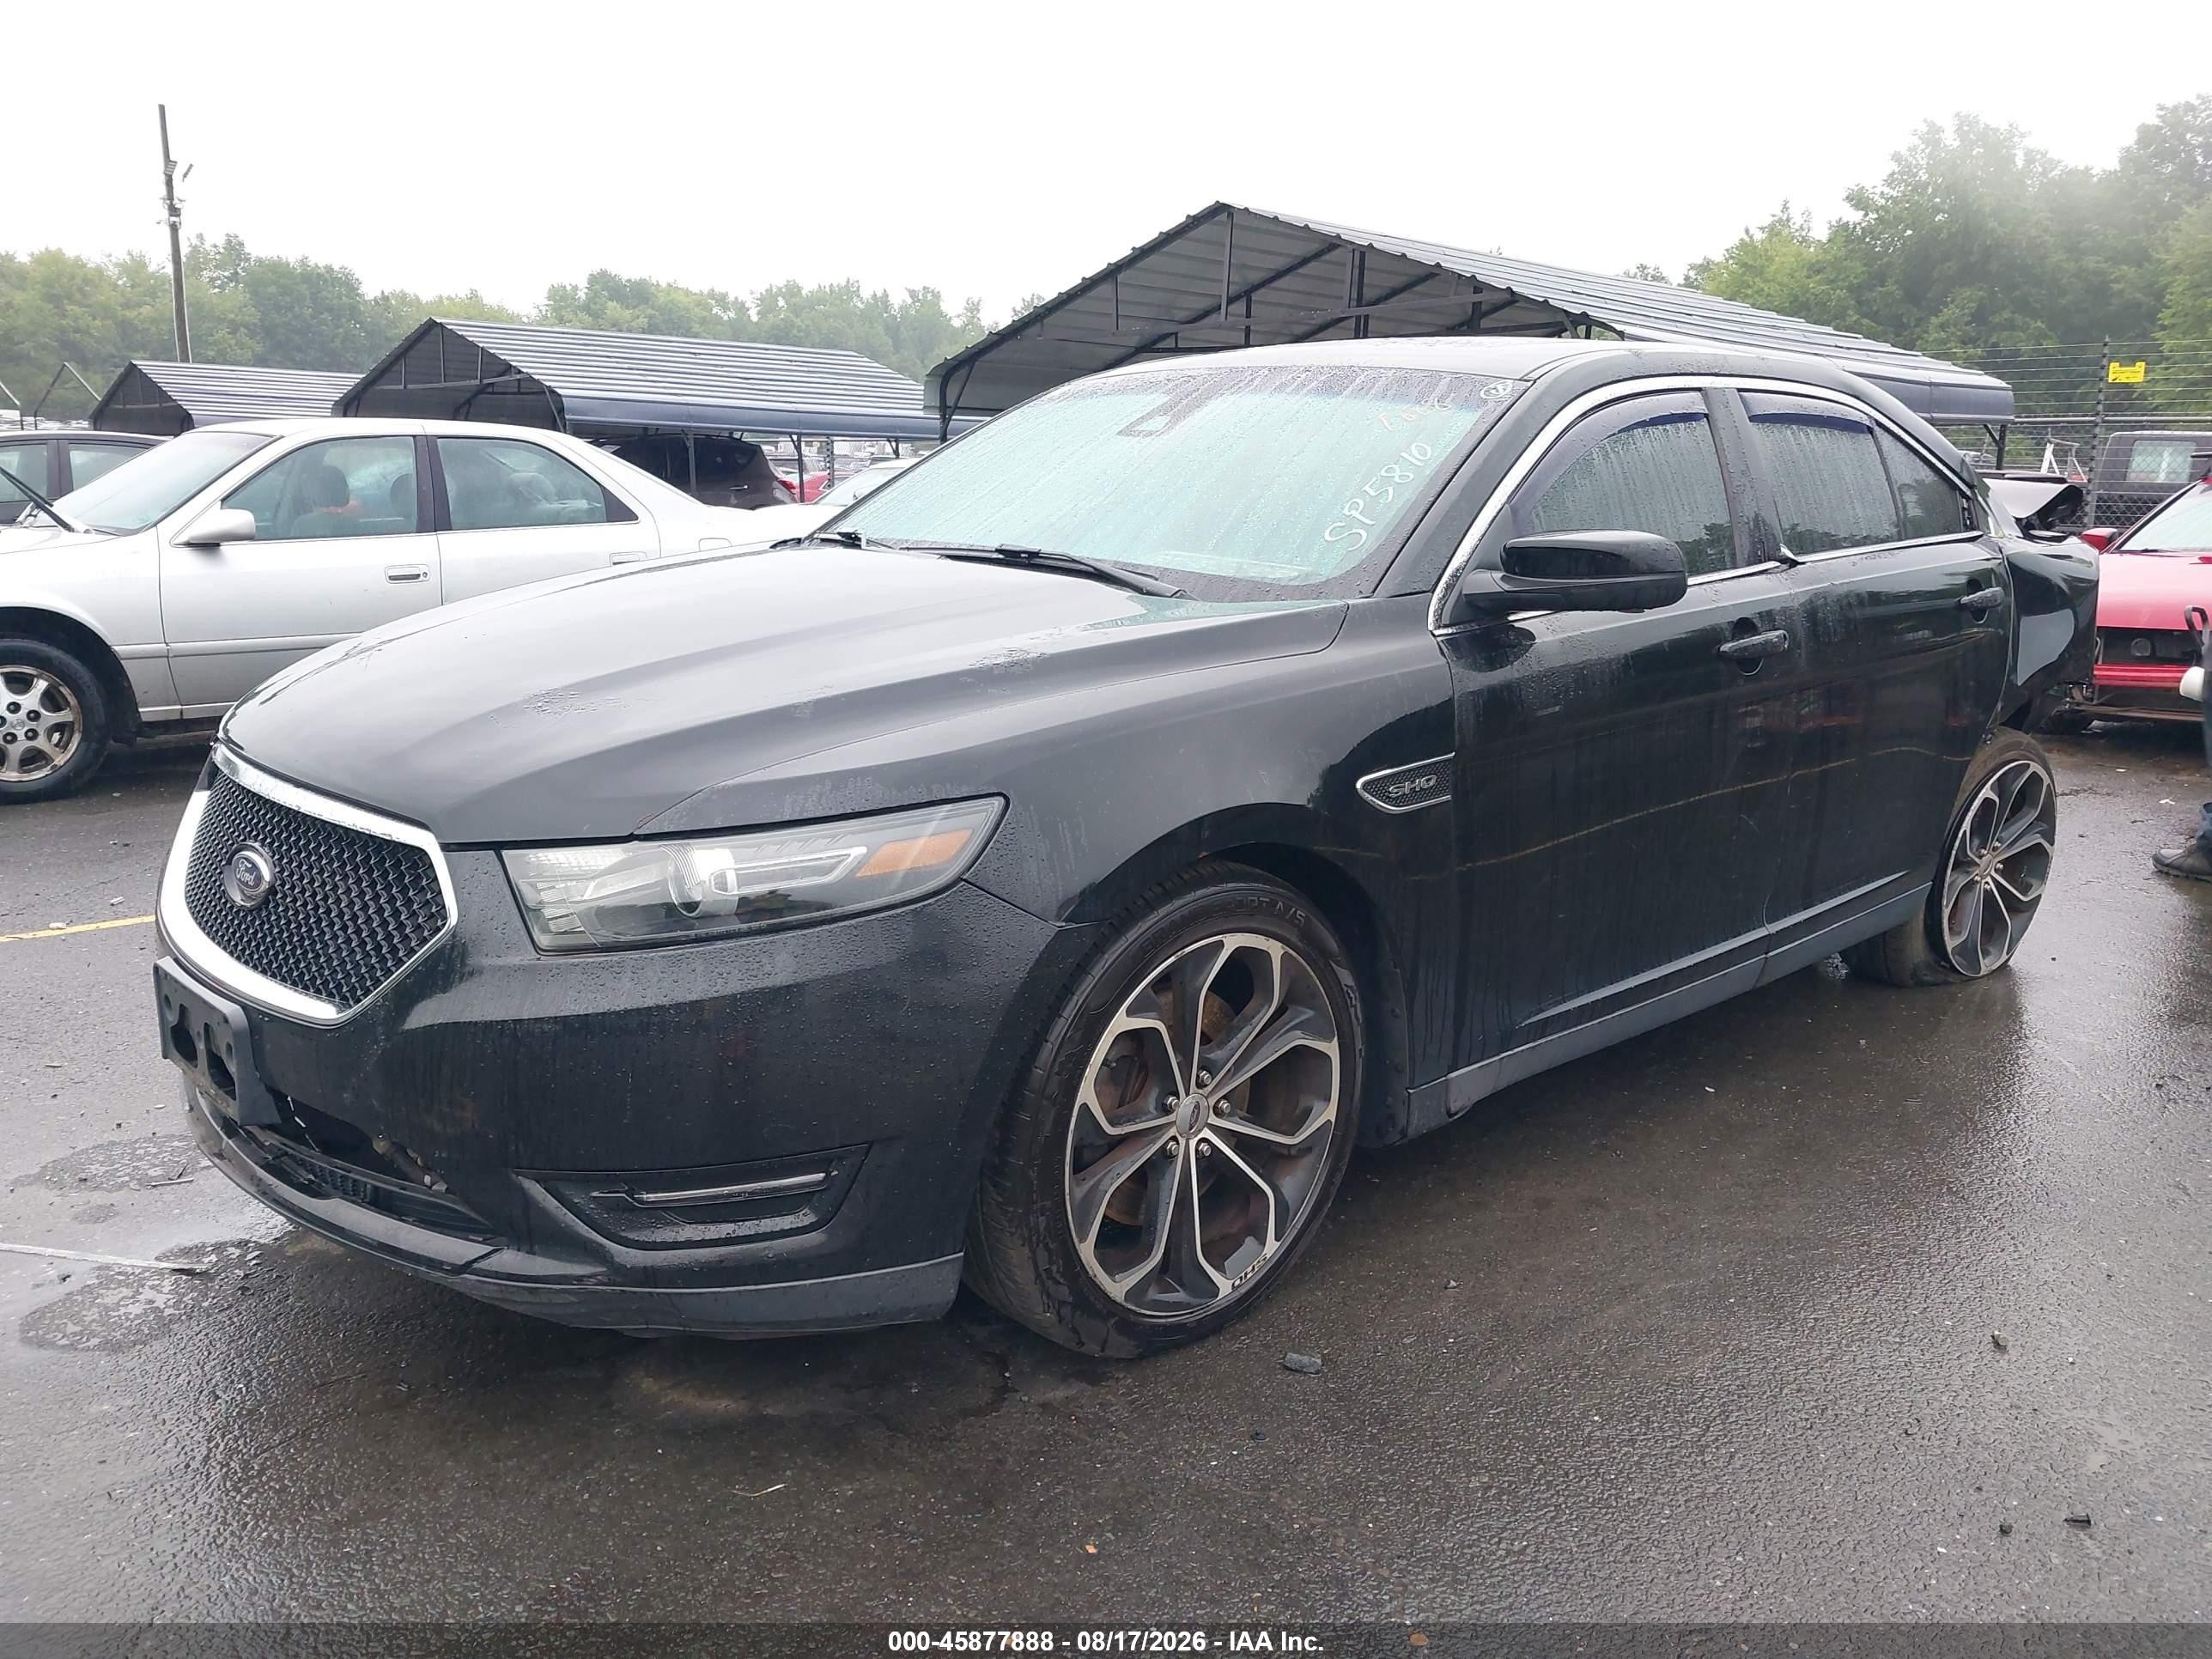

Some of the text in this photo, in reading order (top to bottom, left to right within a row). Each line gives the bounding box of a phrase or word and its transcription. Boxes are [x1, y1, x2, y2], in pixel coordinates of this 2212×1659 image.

[1323, 441, 1432, 551] SP5810
[1389, 775, 1437, 798] SHO
[235, 859, 257, 886] Ford
